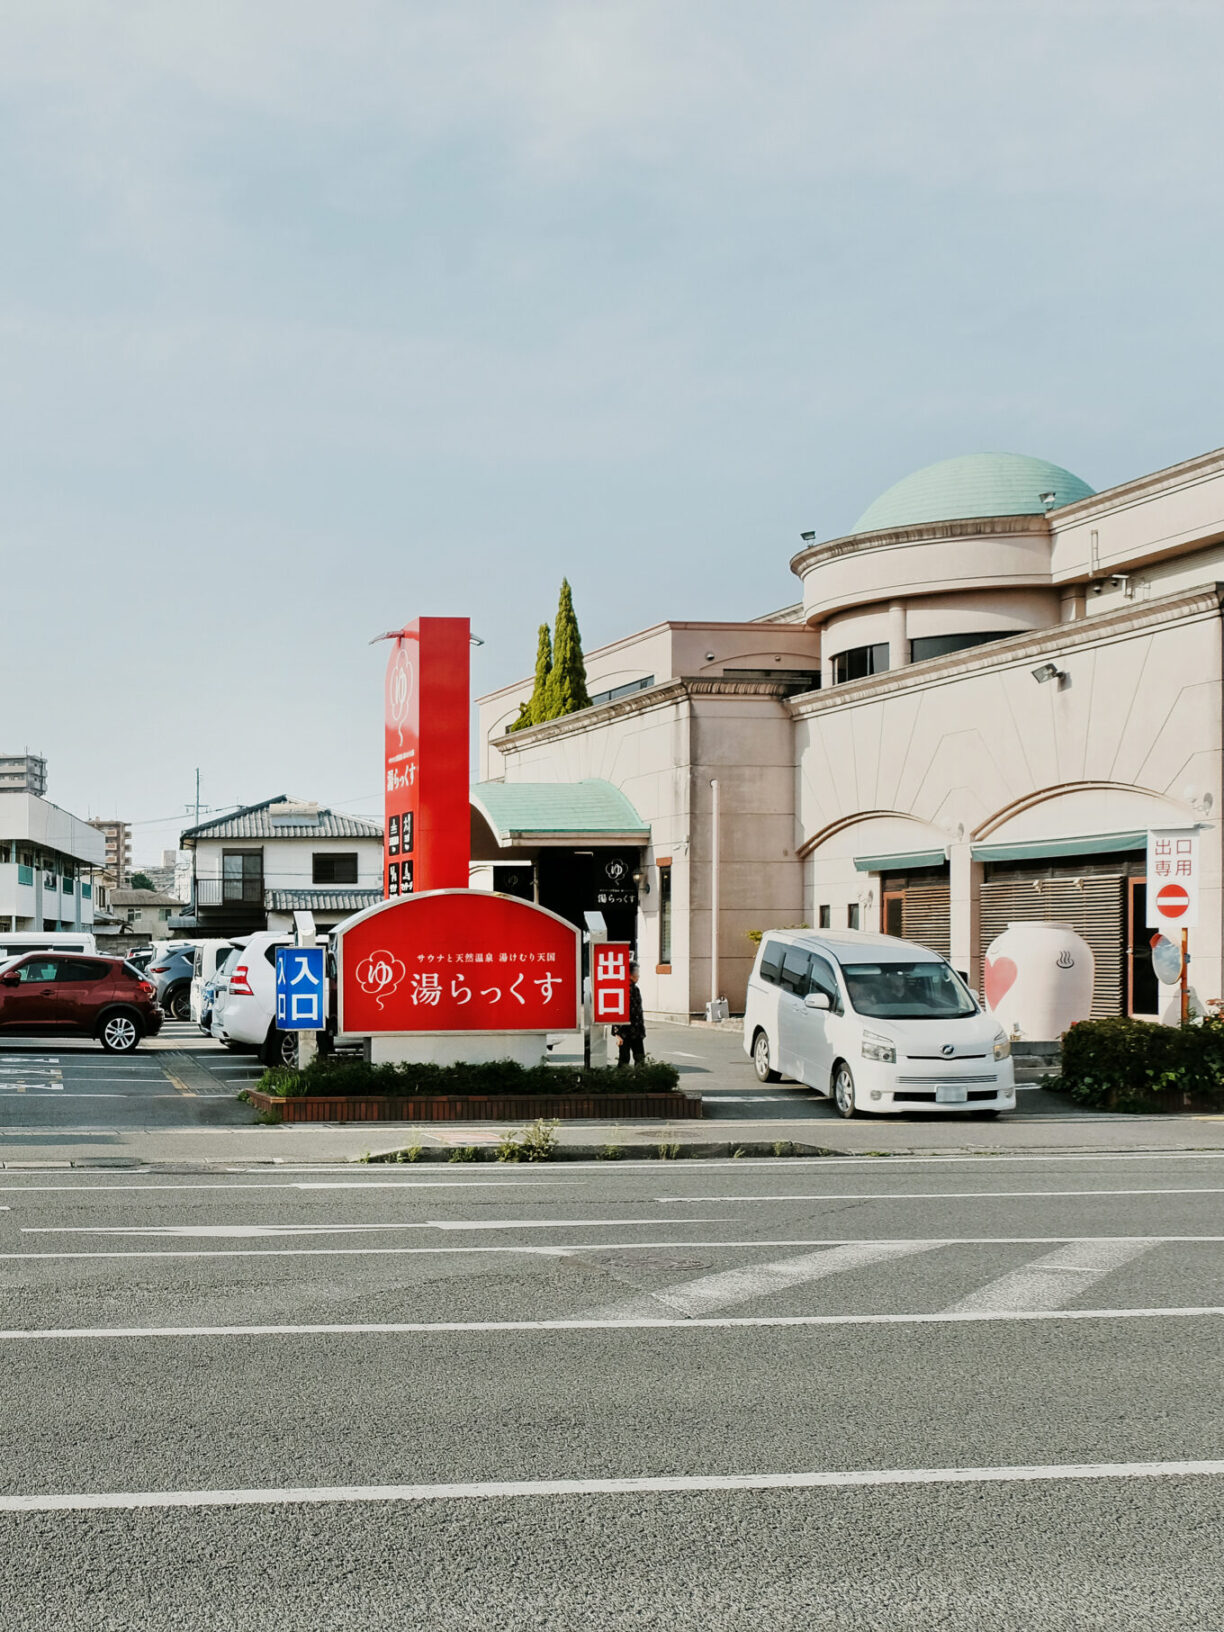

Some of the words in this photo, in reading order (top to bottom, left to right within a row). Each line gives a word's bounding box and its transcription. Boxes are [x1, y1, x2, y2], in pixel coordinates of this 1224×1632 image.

[1155, 839, 1192, 855] 出口
[1155, 860, 1192, 876] 専用
[417, 953, 494, 963] サウナと天然温泉
[499, 952, 556, 963] 湯けむり天国
[278, 957, 286, 1020] 入口
[290, 957, 319, 1020] 入口
[410, 972, 563, 1006] 湯らっくす
[597, 951, 626, 1015] 出口
